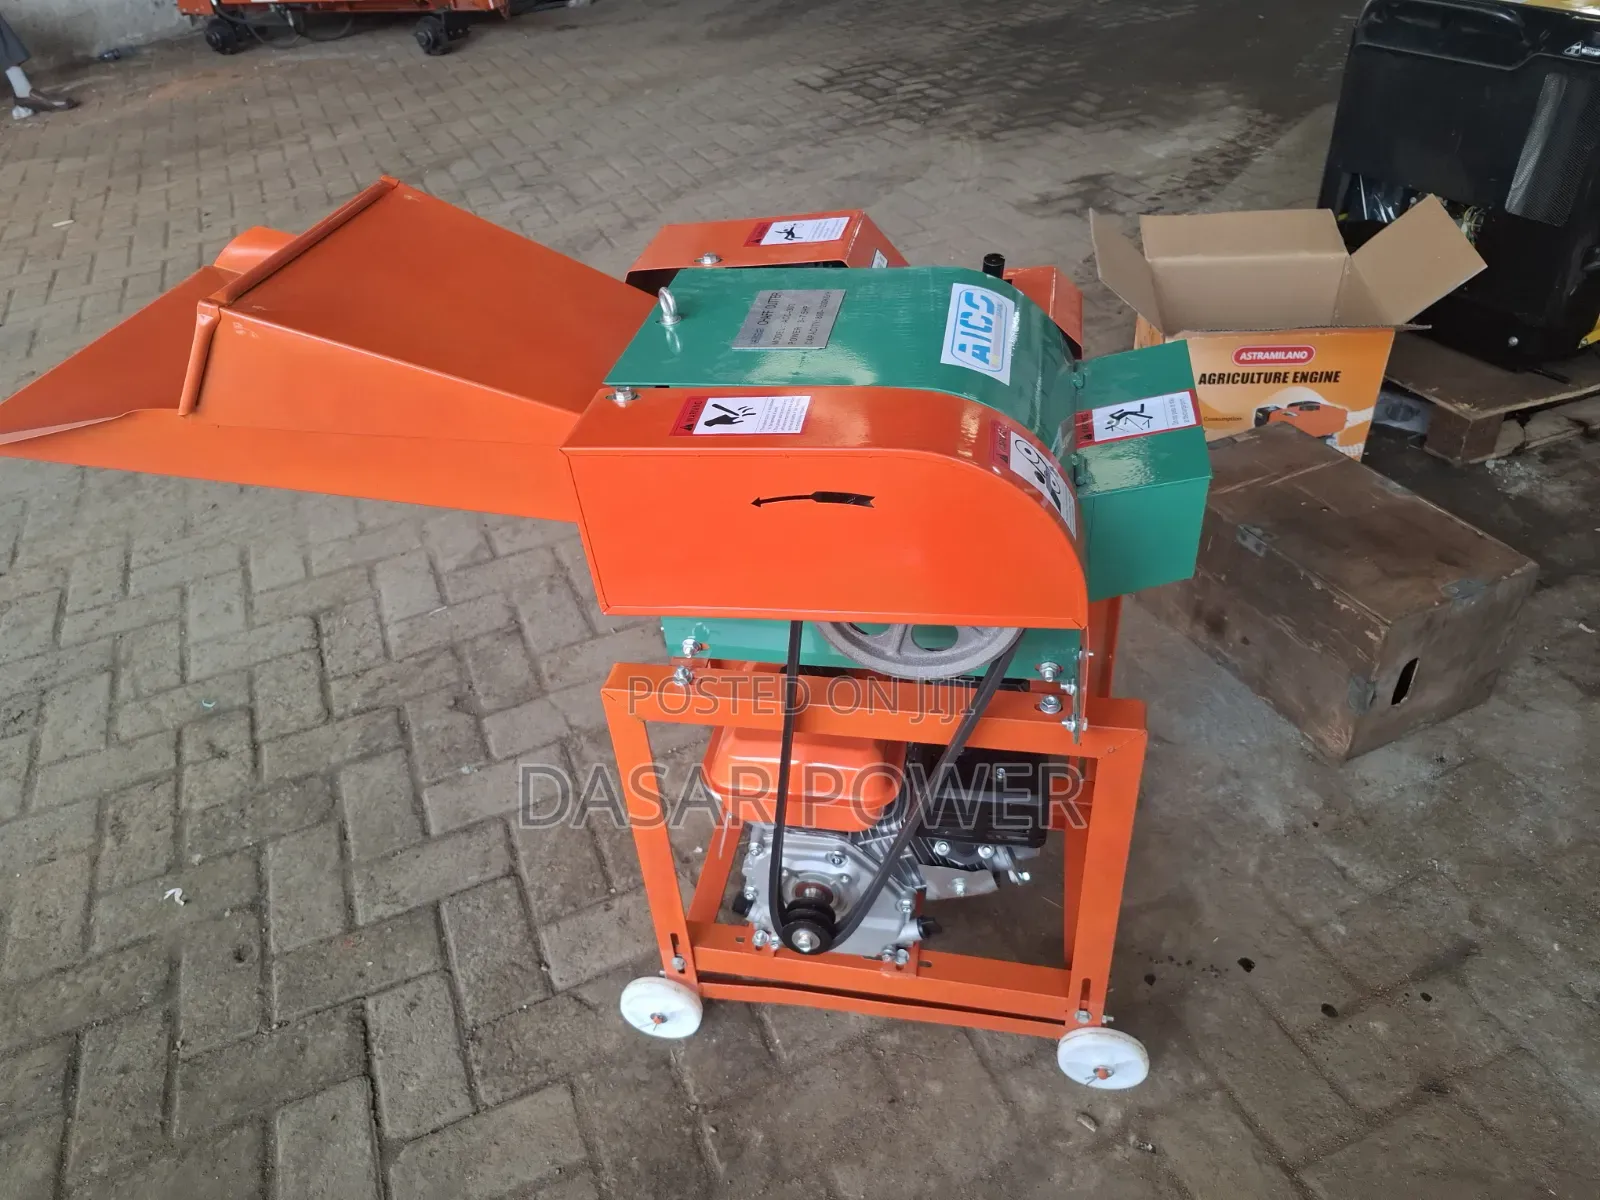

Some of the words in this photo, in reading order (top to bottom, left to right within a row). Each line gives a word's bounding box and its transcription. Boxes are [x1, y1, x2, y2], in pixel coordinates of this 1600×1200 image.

[958, 291, 995, 365] AICS
[1239, 351, 1308, 361] ASTRAMILANO
[1198, 371, 1290, 385] AGRICULTURE
[1292, 370, 1342, 384] ENGINE
